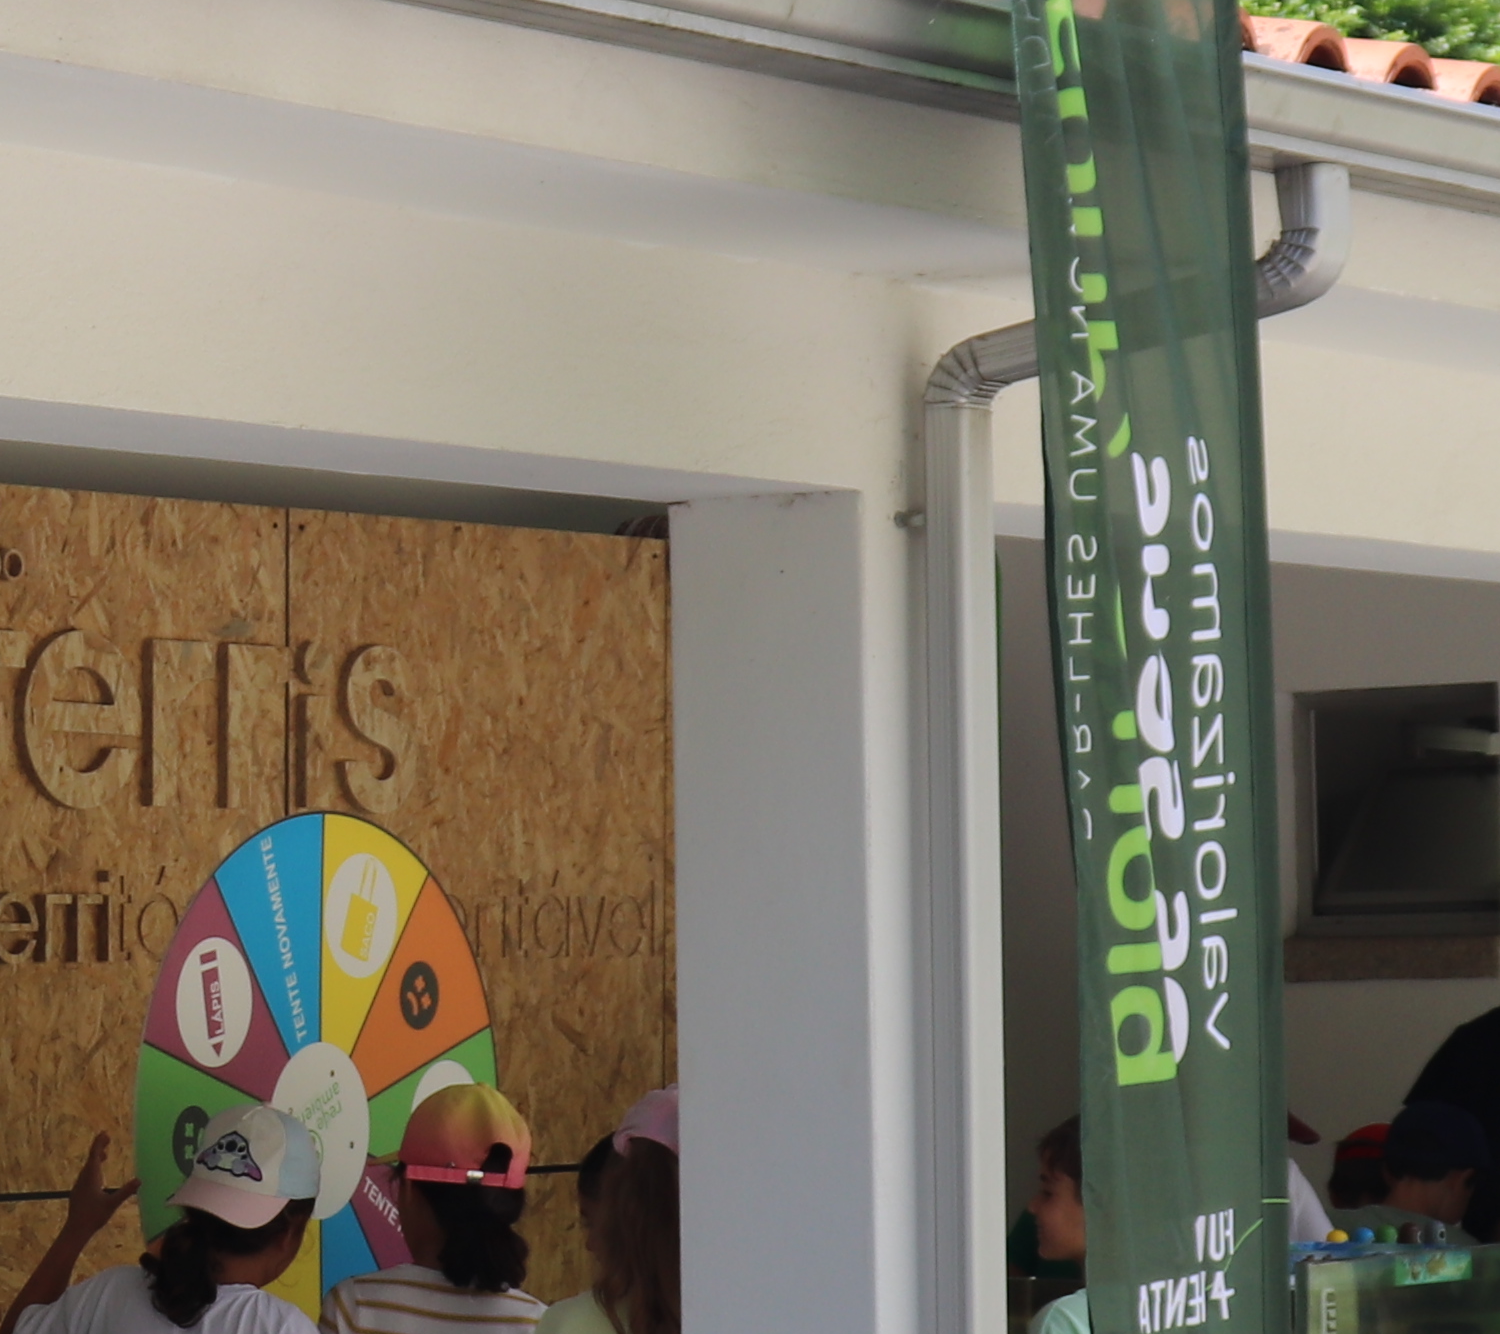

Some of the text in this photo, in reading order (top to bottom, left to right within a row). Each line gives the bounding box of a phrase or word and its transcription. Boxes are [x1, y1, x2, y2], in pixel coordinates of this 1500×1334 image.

[260, 835, 308, 1043] TENTE NOVAMENTE
[359, 912, 376, 961] SACO
[363, 1176, 400, 1227] TENTE
